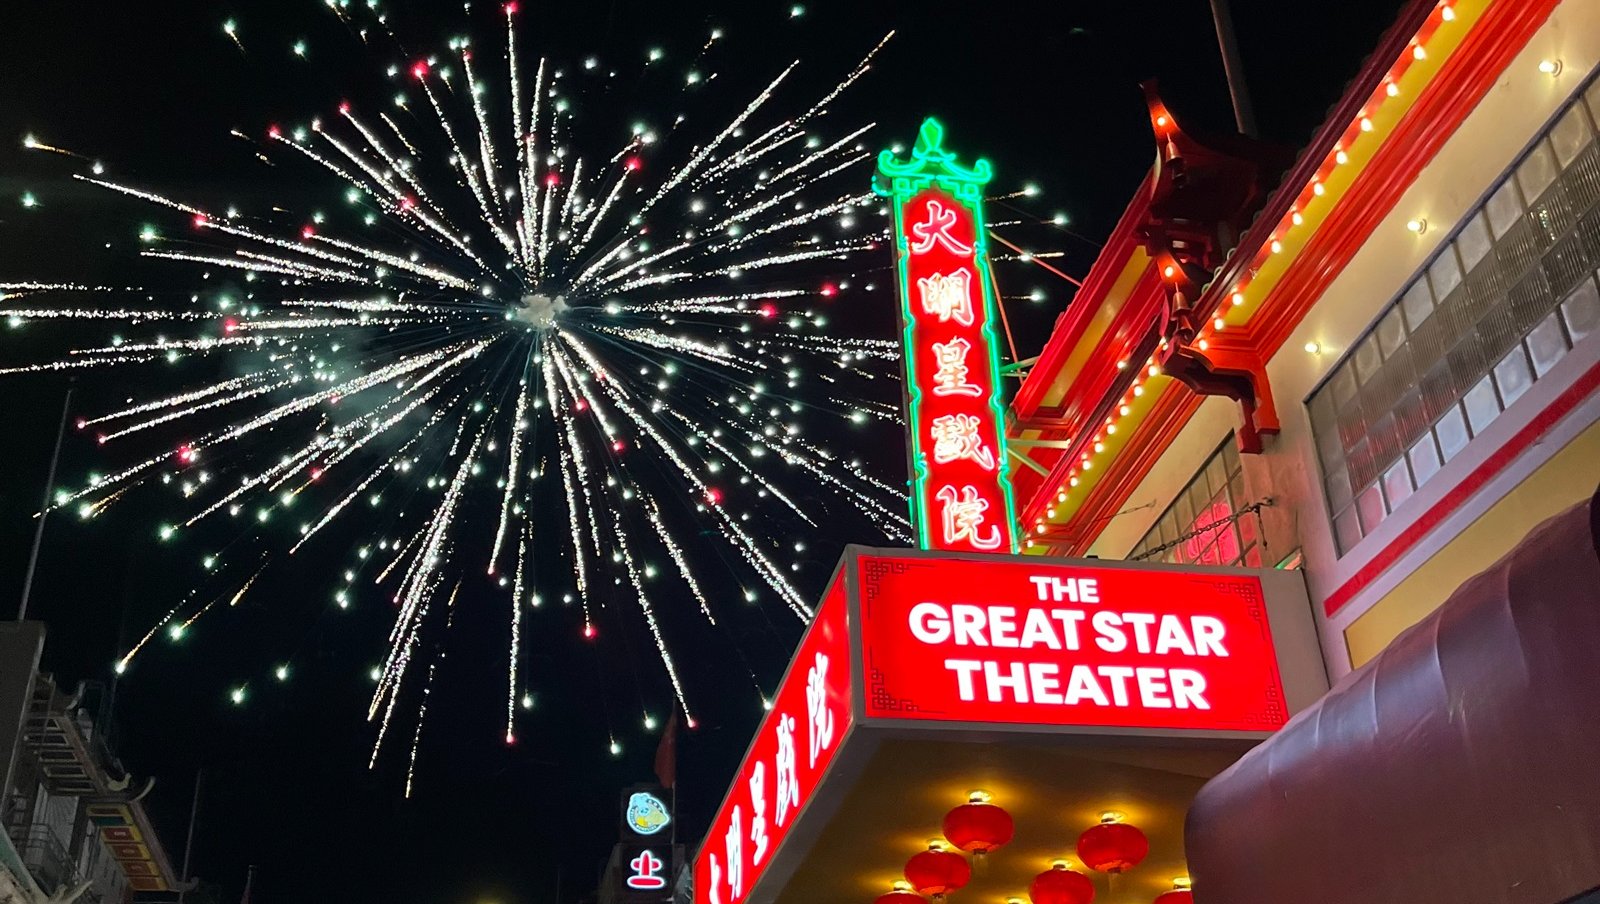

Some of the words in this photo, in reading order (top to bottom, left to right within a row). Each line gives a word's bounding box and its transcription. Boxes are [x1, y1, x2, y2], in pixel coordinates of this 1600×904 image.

[1030, 576, 1099, 602] THE
[909, 602, 1084, 651] GREAT
[1093, 610, 1228, 657] STAR
[945, 659, 1210, 710] THEATER
